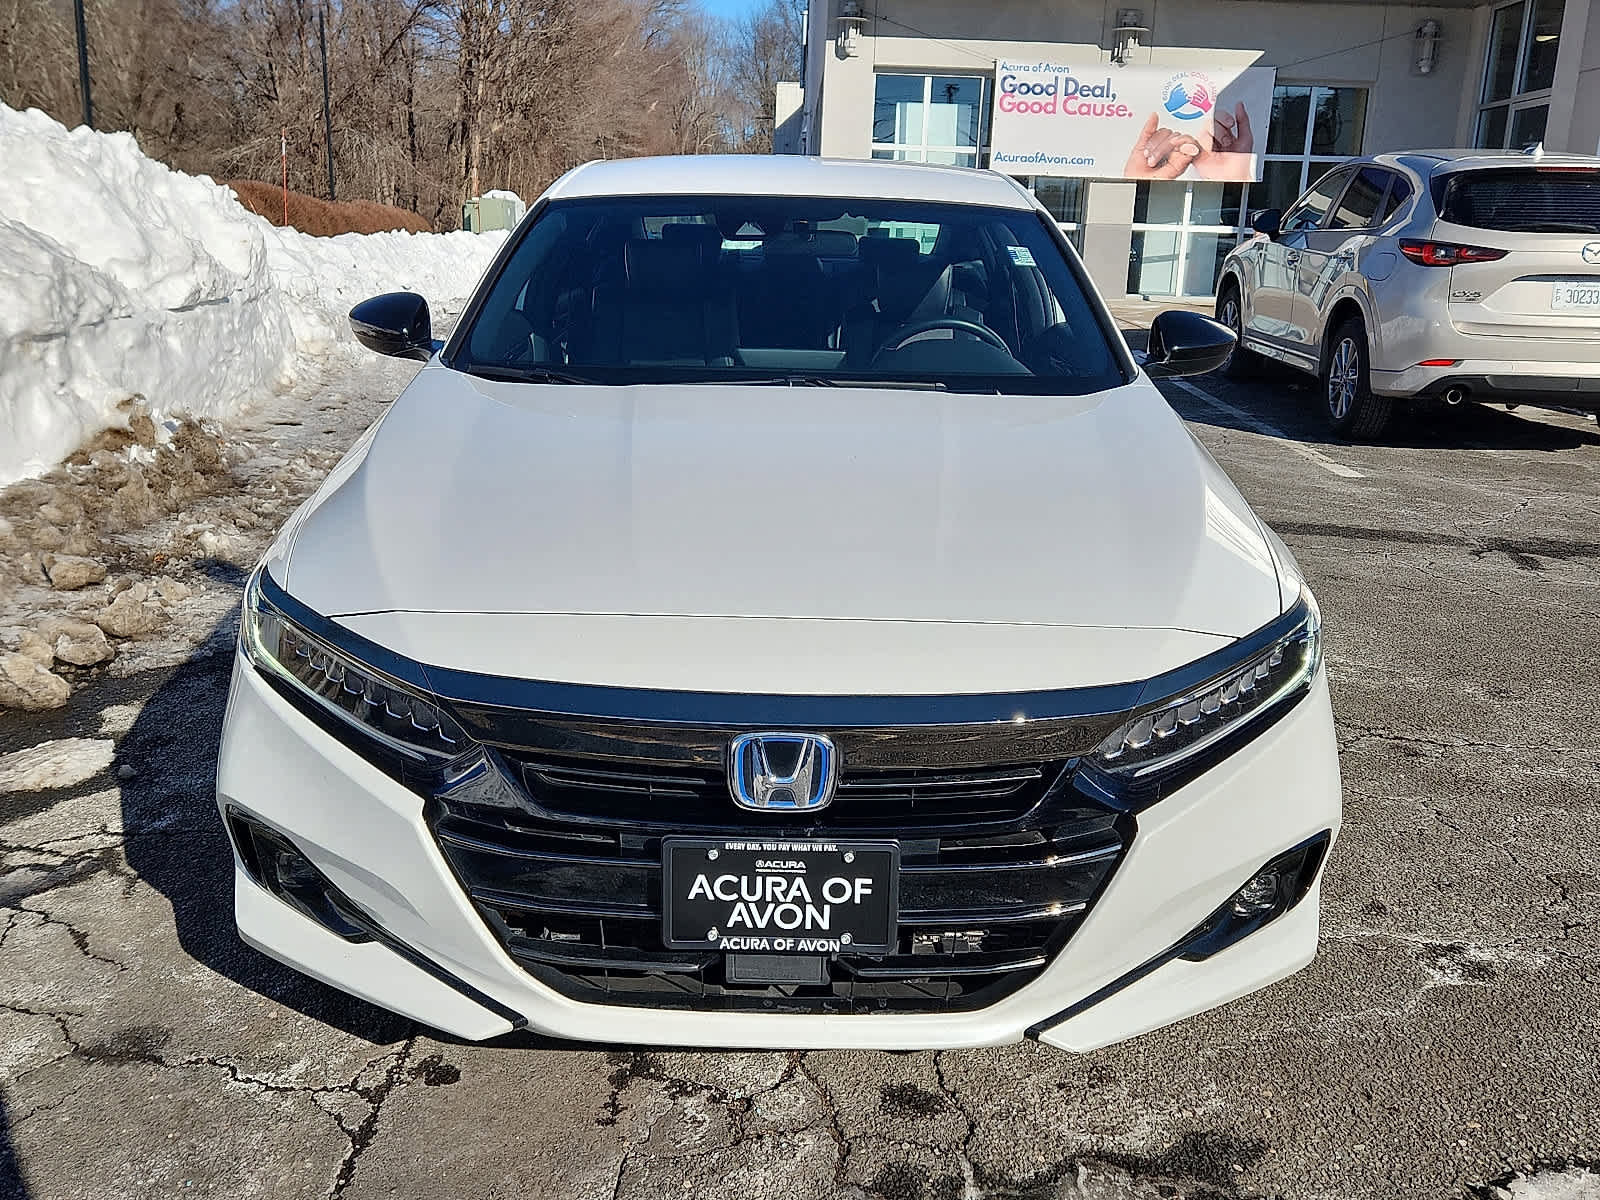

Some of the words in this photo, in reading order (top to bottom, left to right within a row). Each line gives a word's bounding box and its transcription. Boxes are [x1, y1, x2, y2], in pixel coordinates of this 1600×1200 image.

[1000, 62, 1028, 74] Acura
[1030, 63, 1042, 73] of
[1044, 63, 1070, 74] Avon
[1000, 75, 1058, 96] Good
[1064, 77, 1117, 103] Deal,
[999, 93, 1057, 115] Good
[1062, 95, 1133, 118] Cause.
[994, 151, 1094, 166] AcuraofAvon.com
[1566, 289, 1600, 304] 30233
[725, 842, 746, 850] EVERY
[763, 843, 777, 851] YOU
[778, 843, 791, 851] PAY
[824, 844, 838, 852] PAY.
[763, 860, 806, 869] ACURA
[688, 874, 813, 903] ACURA
[822, 877, 873, 904] OF
[727, 902, 831, 930] AVON
[719, 937, 770, 951] ACURA
[774, 938, 794, 951] OF
[797, 939, 840, 952] AVON
